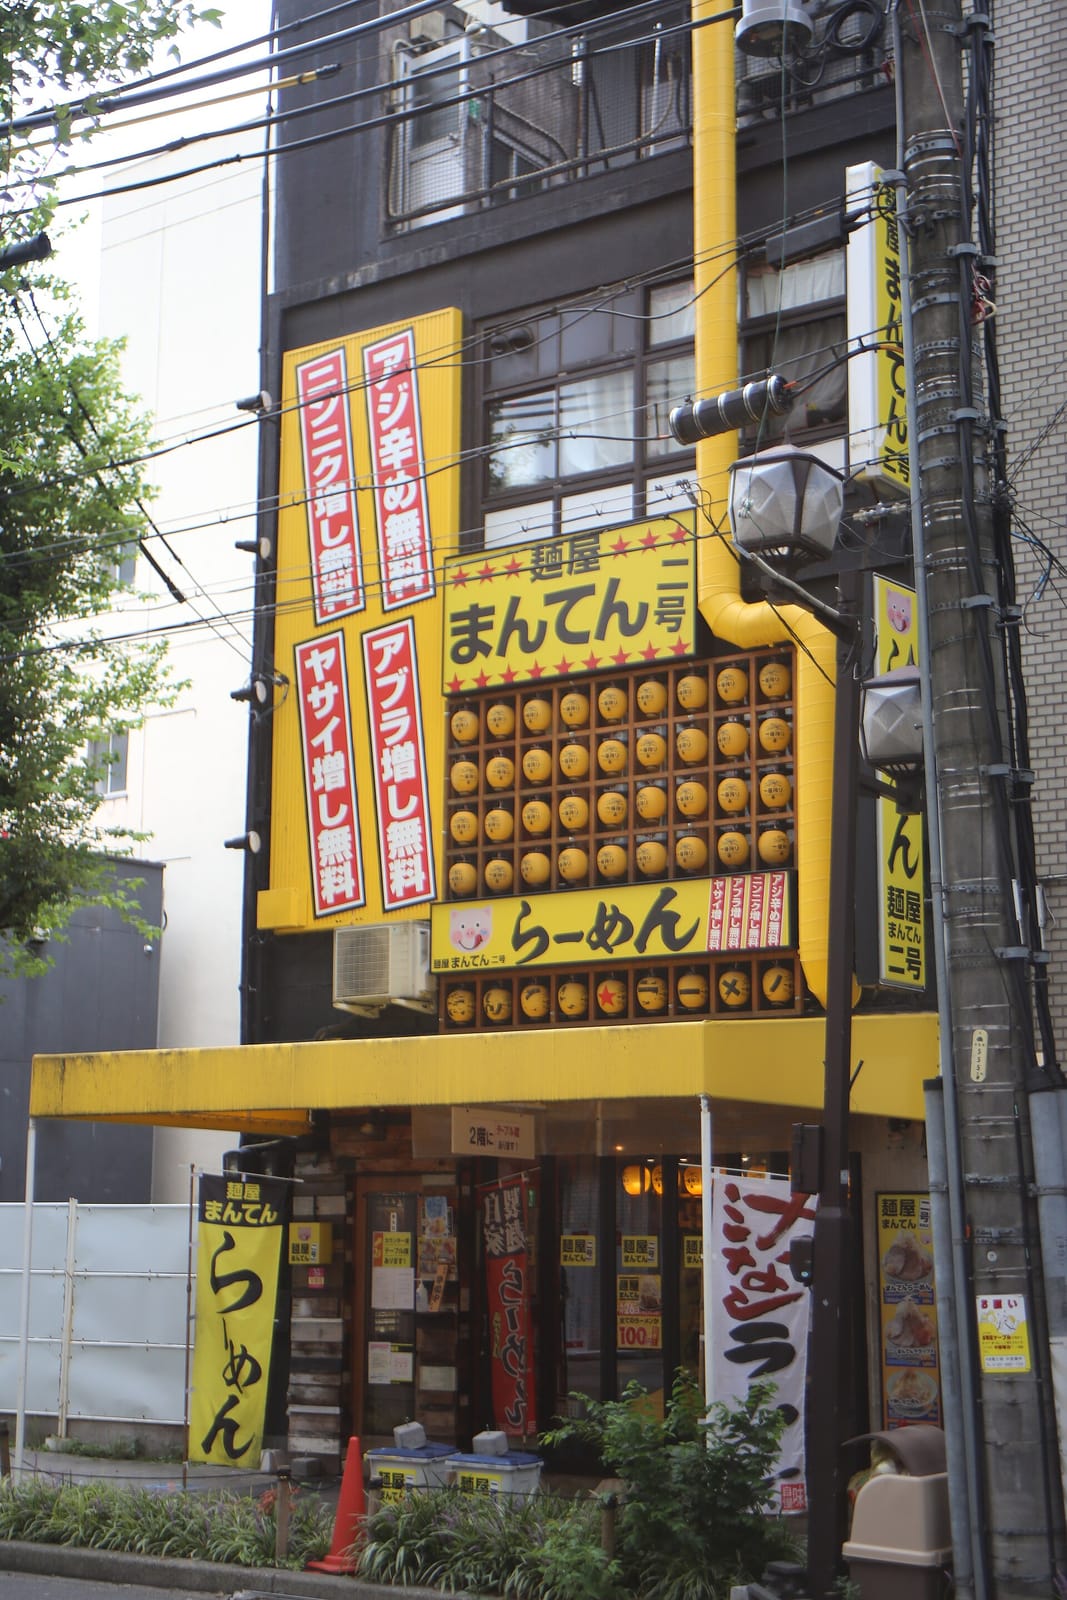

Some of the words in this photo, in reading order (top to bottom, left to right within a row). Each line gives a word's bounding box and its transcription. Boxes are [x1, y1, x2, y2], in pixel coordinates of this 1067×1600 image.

[306, 363, 355, 613] ニンニク増し無料
[372, 342, 426, 598] アジ辛め無料
[530, 531, 601, 583] 麺屋
[654, 558, 689, 633] 二号
[449, 577, 649, 665] まんてん
[304, 647, 356, 904] ヤサイ増し無料
[372, 631, 426, 898] アブラ増し無料
[511, 886, 700, 965] らーめん
[887, 884, 921, 925] 麺屋
[888, 922, 922, 945] まんてん
[451, 954, 490, 968] まんてん
[491, 953, 506, 964] 二号
[888, 943, 922, 981] 二号
[205, 1200, 277, 1224] まんてん
[226, 1182, 260, 1200] 麺屋
[882, 1199, 916, 1217] 麺屋
[881, 1218, 916, 1230] まんてん
[201, 1230, 263, 1460] らーめん
[619, 1326, 647, 1345] 100
